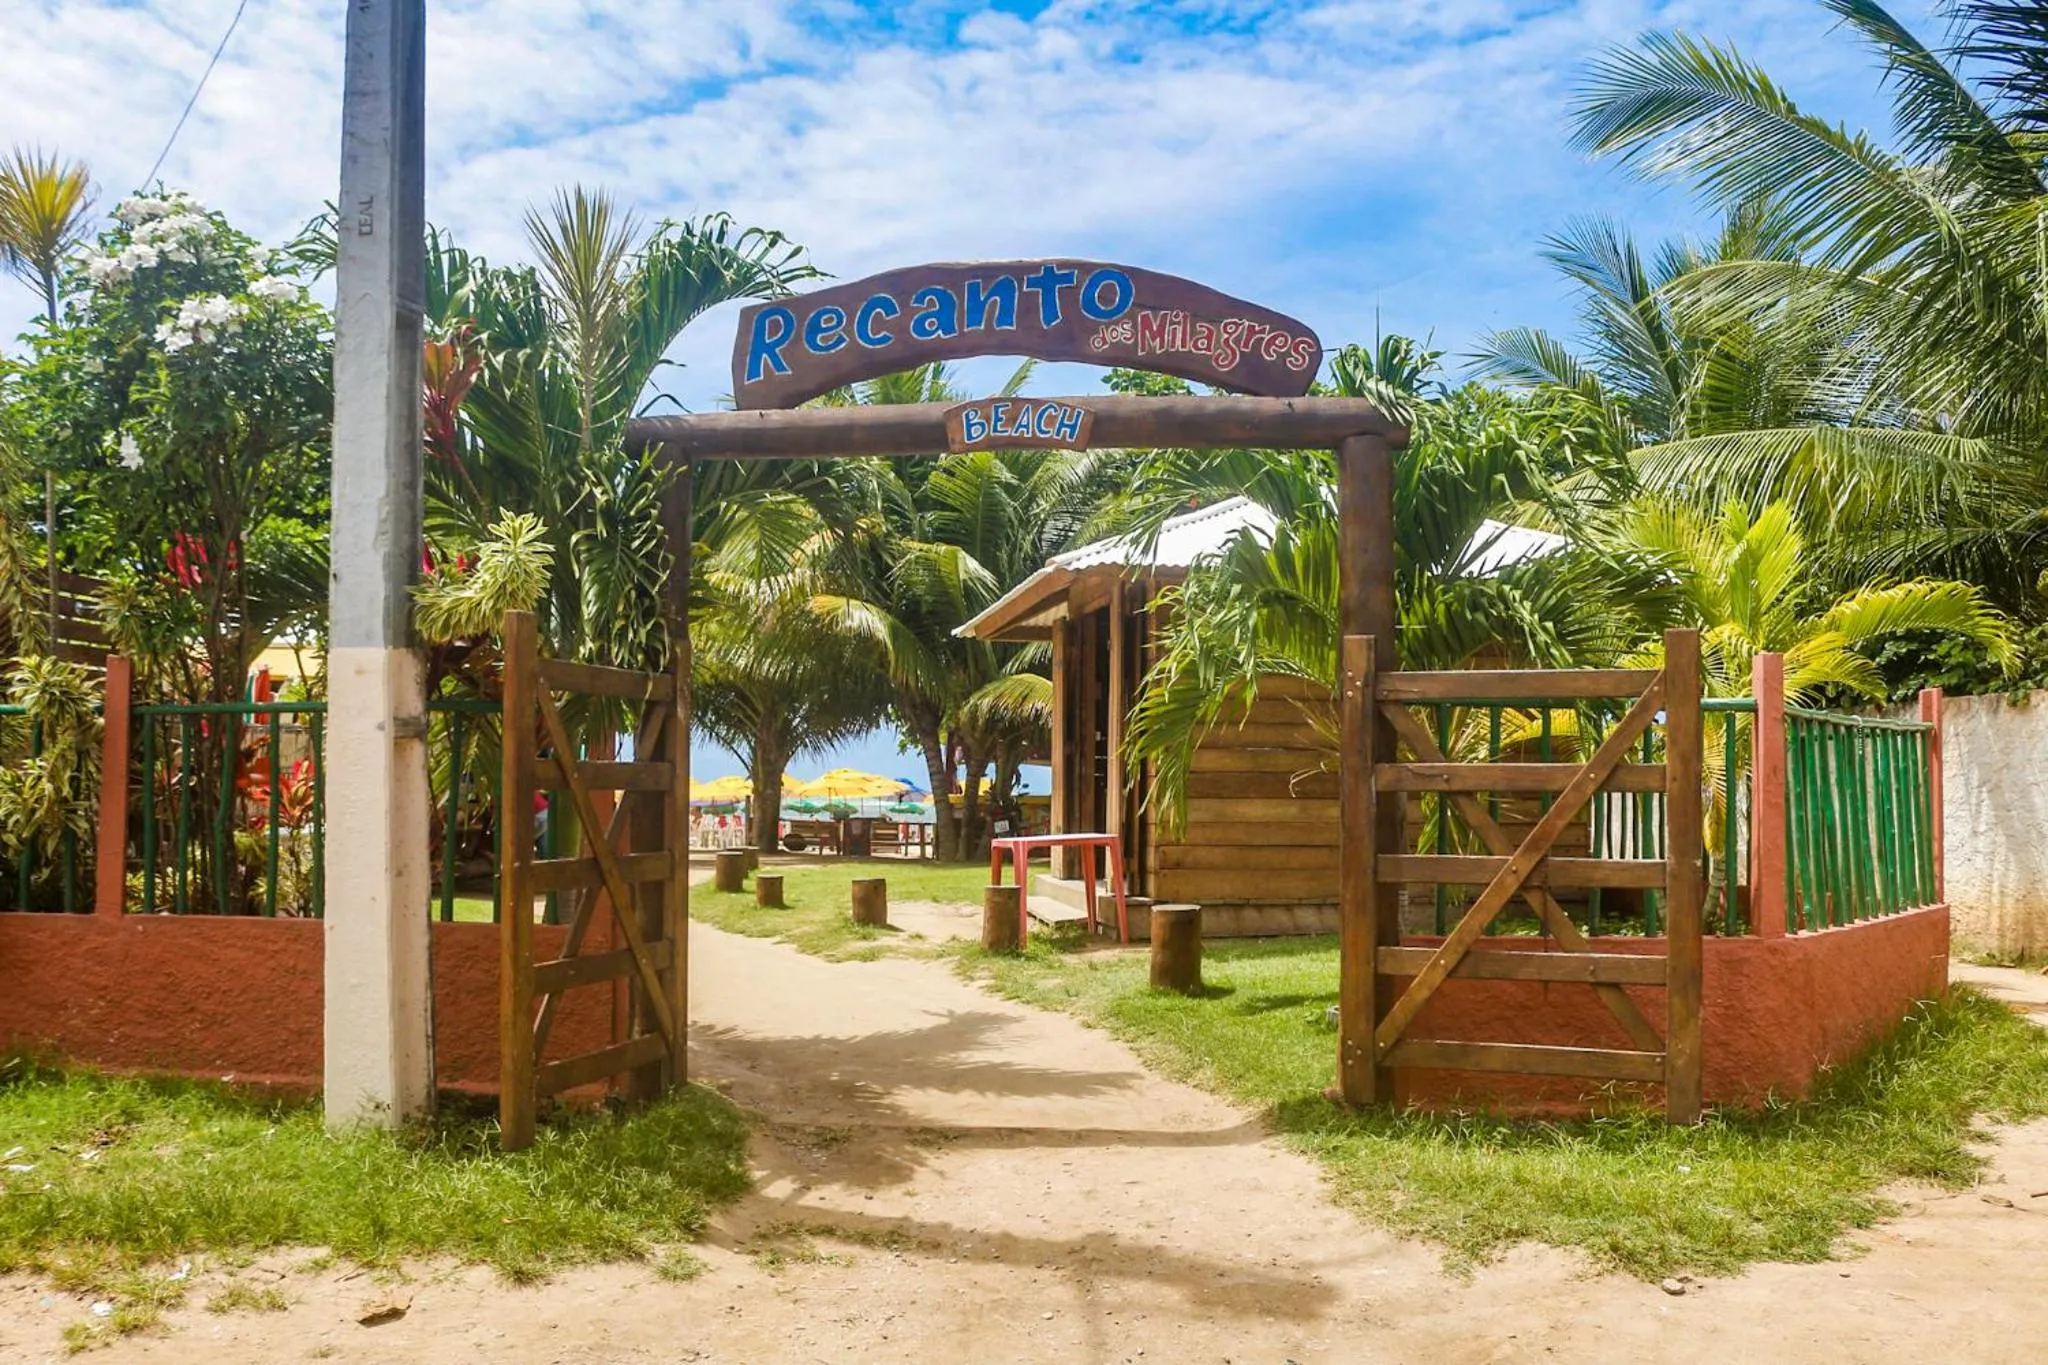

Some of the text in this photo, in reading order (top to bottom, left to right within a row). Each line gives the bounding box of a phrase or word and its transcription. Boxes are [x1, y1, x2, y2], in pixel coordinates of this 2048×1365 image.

[744, 264, 1136, 385] Recanto
[1090, 309, 1317, 372] dos Milagres
[962, 402, 1085, 444] BEACH
